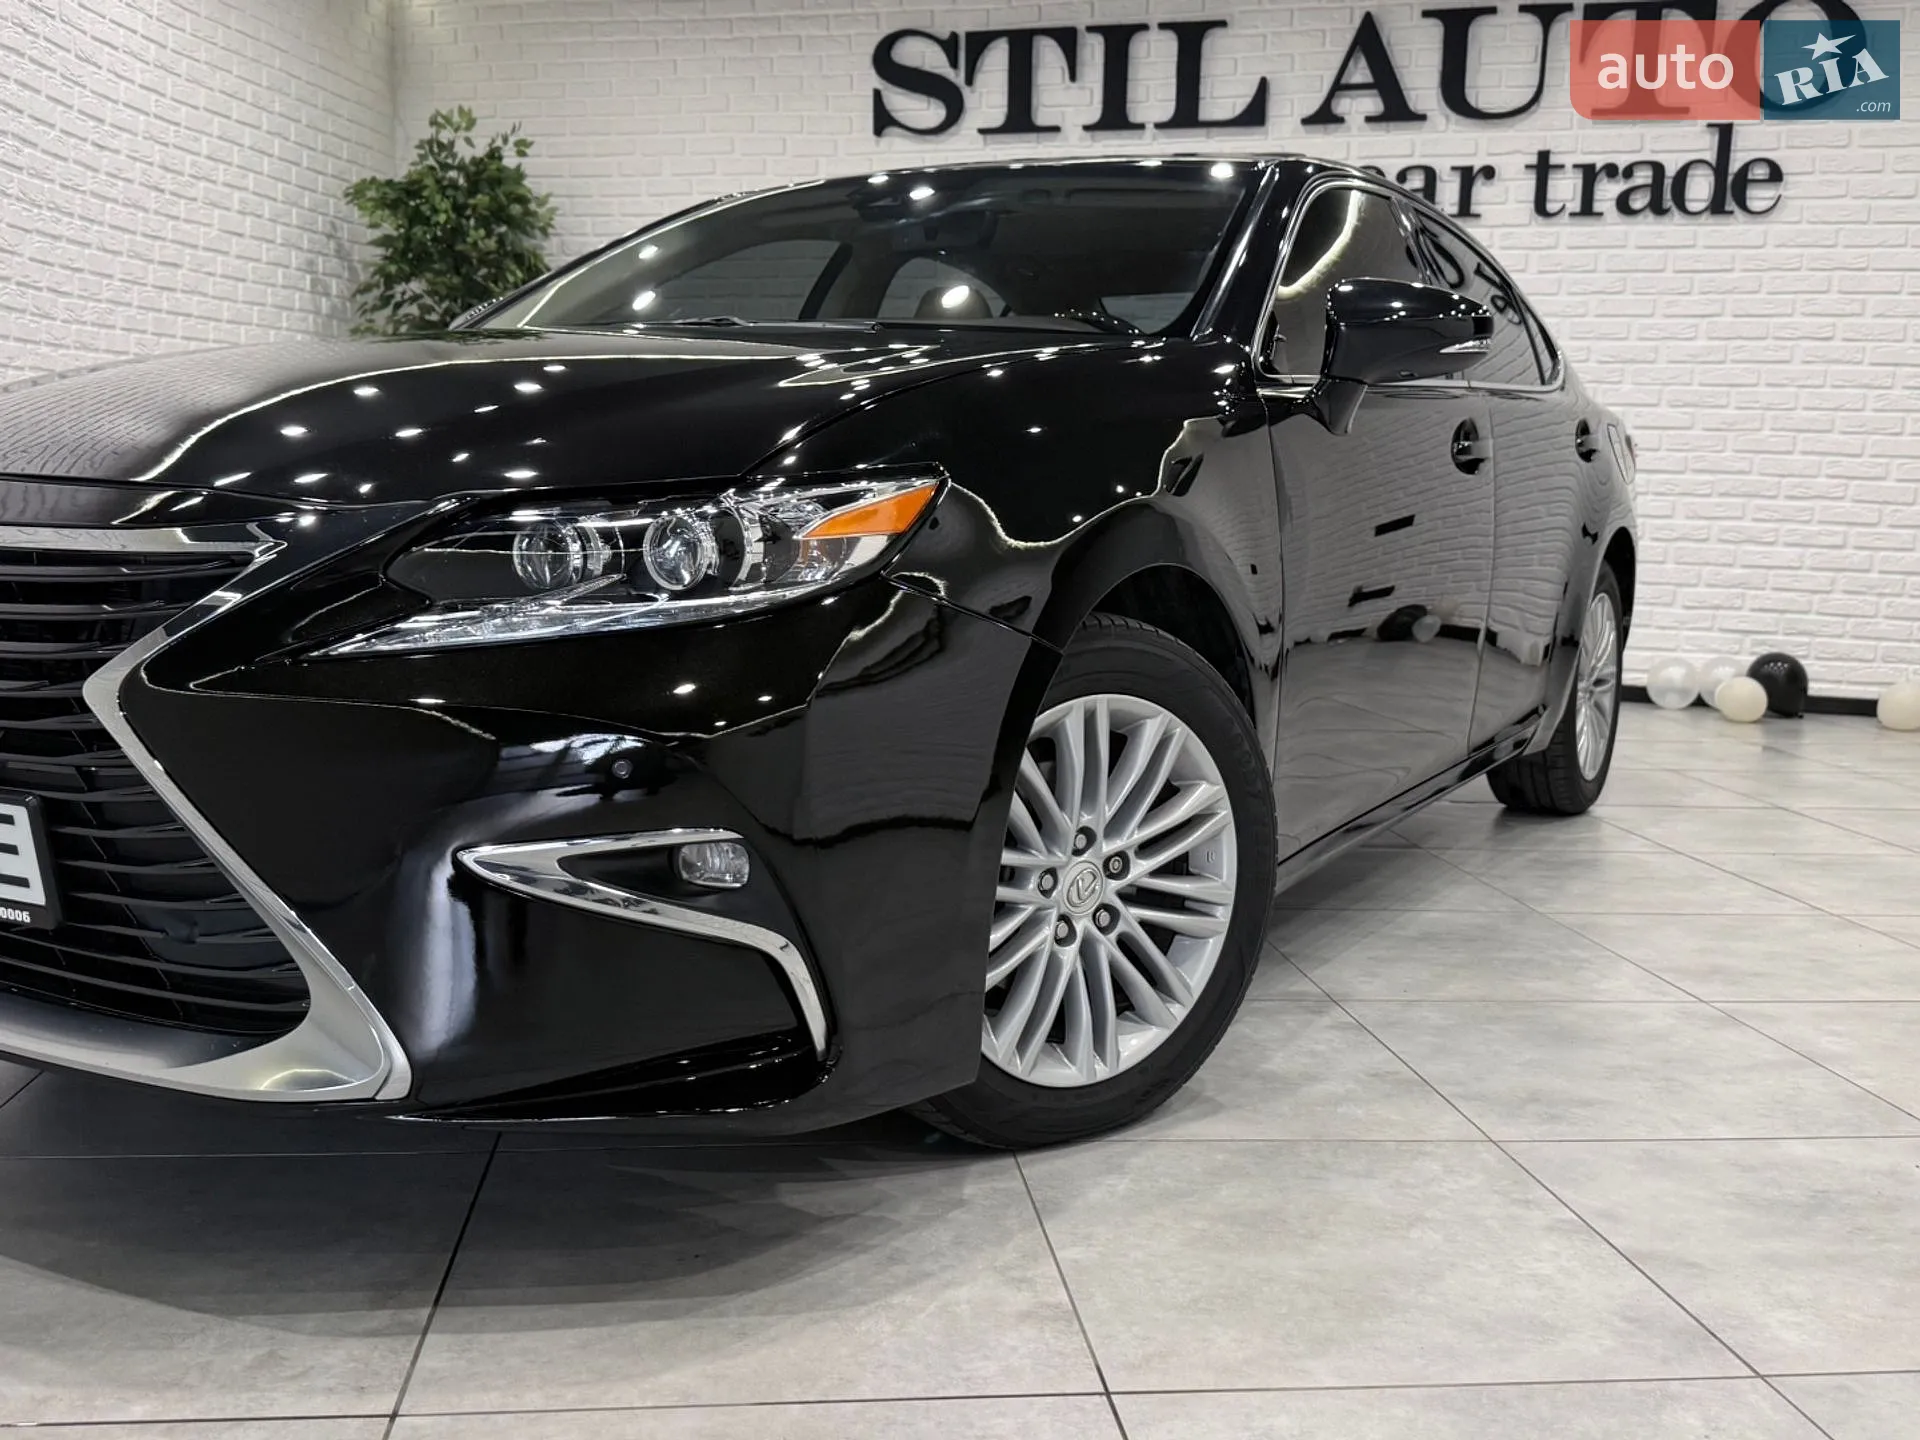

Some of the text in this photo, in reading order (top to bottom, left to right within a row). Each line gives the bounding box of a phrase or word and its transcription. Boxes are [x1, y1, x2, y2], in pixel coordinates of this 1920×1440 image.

[872, 0, 1867, 138] STIL AUTO
[1359, 121, 1784, 219] ar trade
